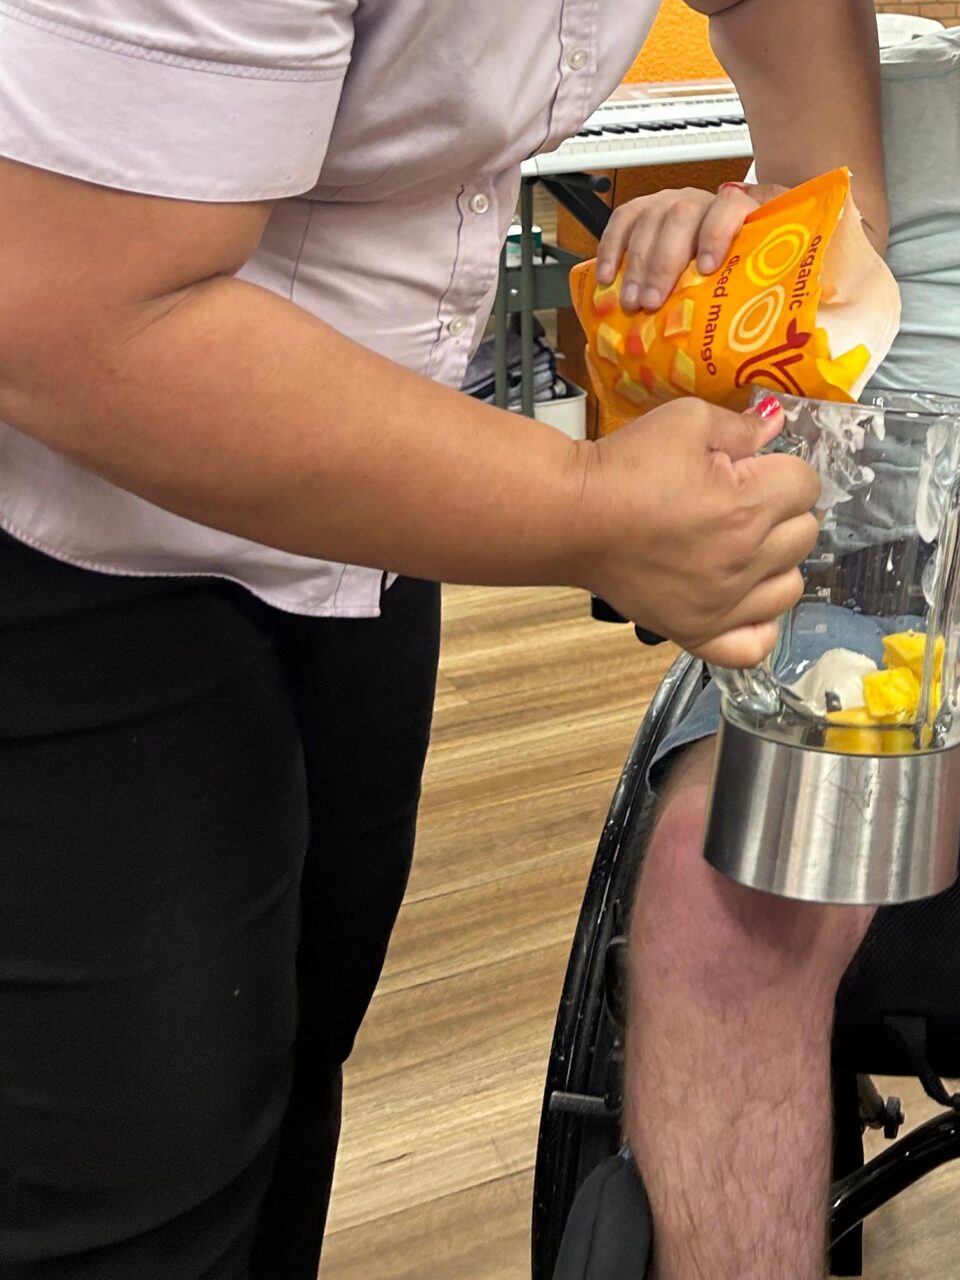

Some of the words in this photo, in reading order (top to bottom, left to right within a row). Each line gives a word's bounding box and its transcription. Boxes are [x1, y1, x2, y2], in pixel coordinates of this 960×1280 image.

[712, 254, 740, 299] diced
[789, 235, 822, 311] organic
[701, 304, 722, 376] mango
